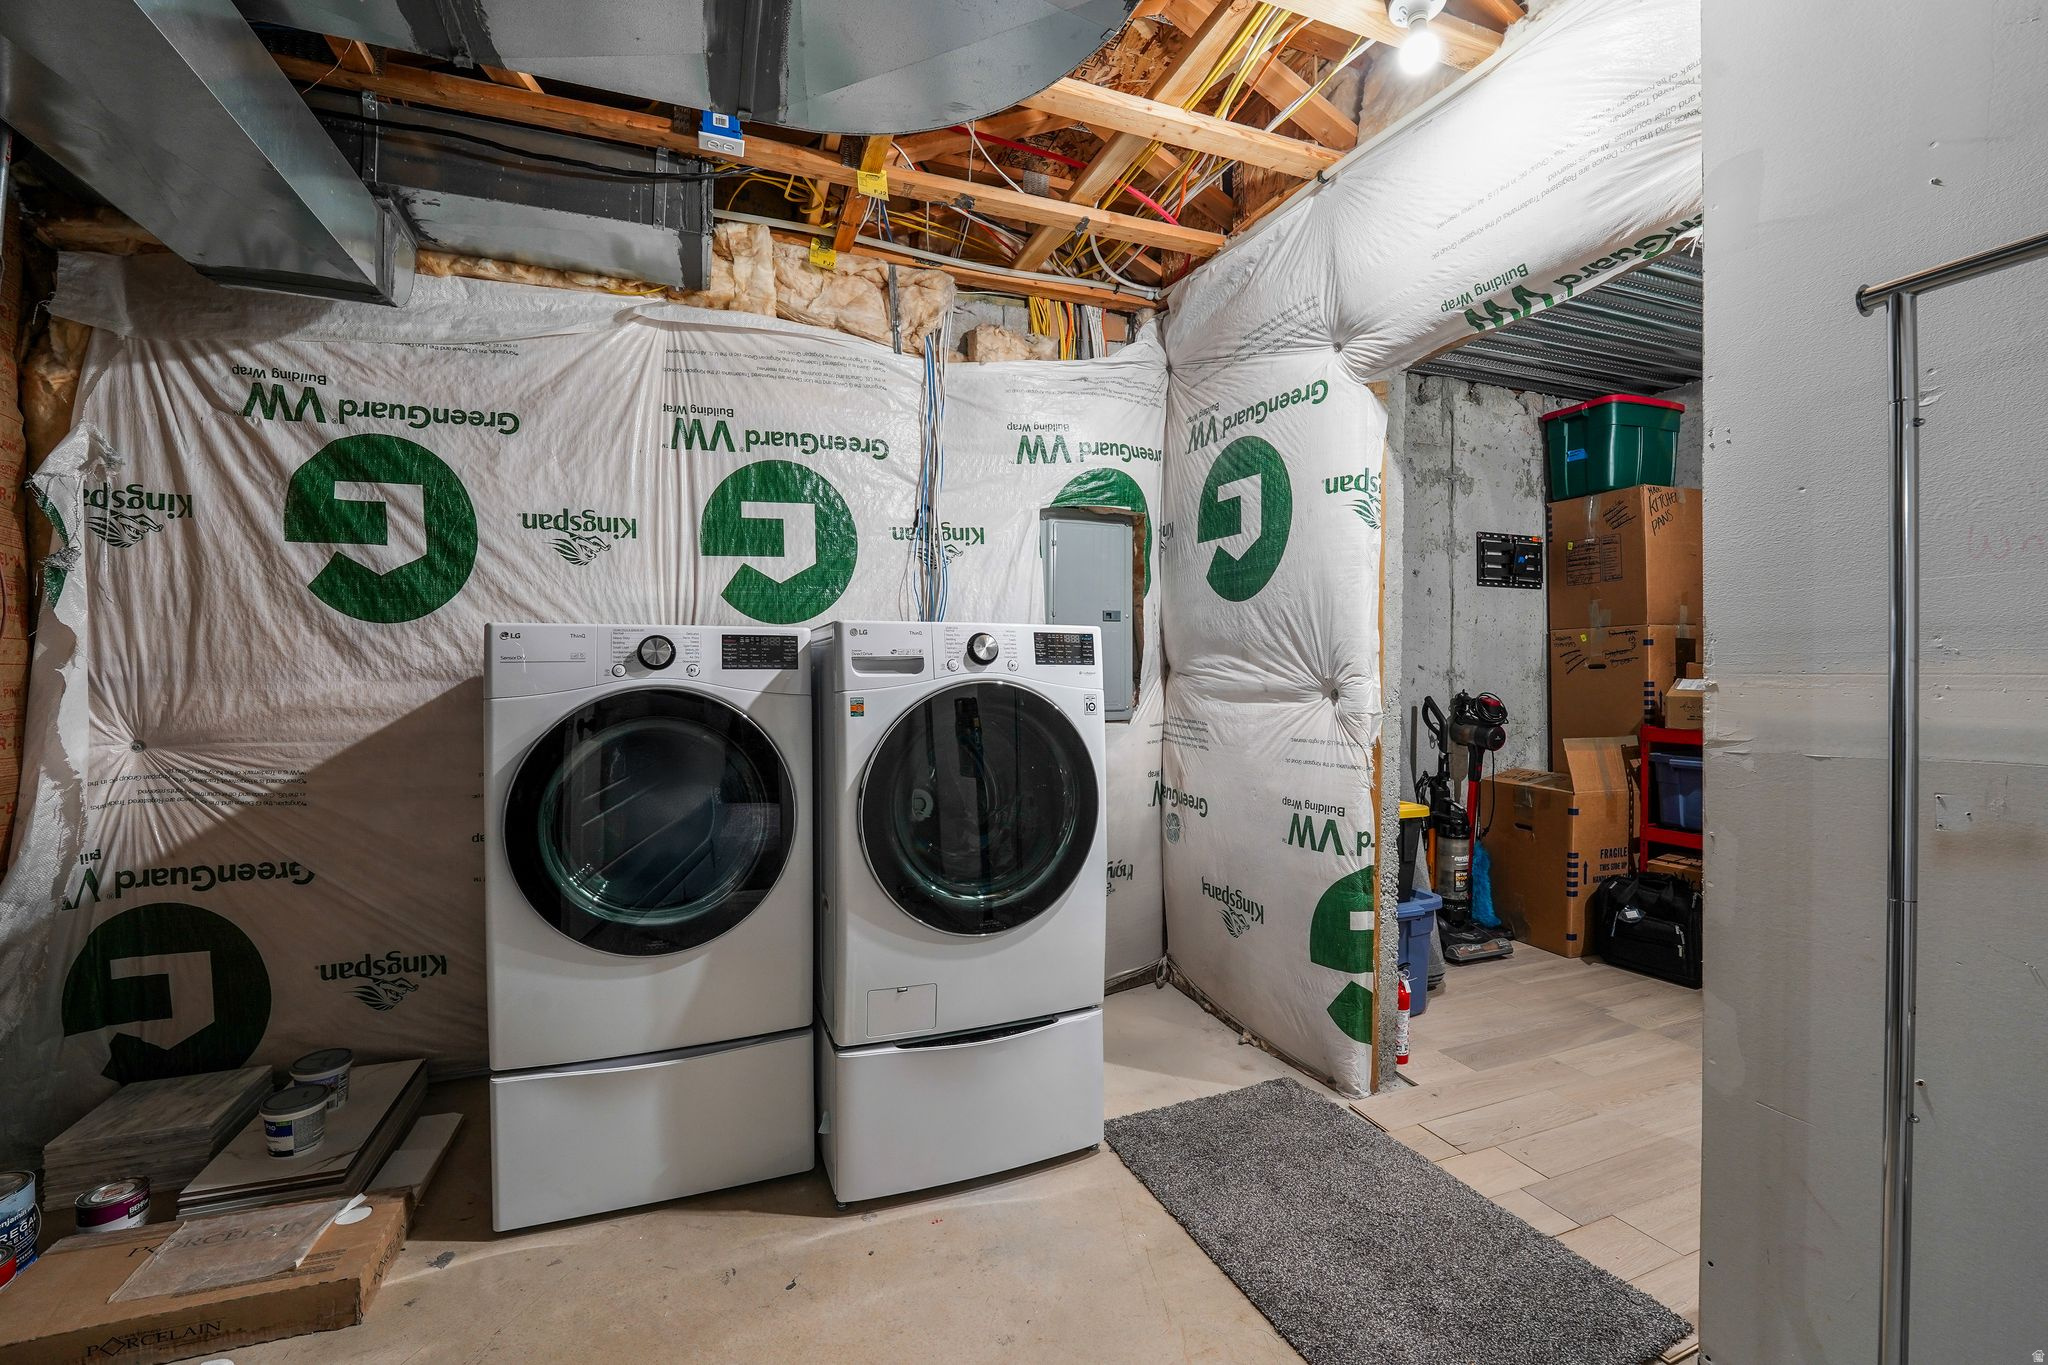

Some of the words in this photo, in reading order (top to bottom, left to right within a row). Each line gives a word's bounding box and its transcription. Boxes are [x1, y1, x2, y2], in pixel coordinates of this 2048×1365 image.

[1474, 262, 1528, 301] Building
[1440, 290, 1473, 314] Wrap
[231, 364, 266, 378] Wrap
[272, 368, 327, 385] Building
[689, 405, 734, 418] Building
[1651, 509, 1674, 536] PANS
[1281, 797, 1303, 810] Wrap
[1304, 799, 1346, 817] Building
[1600, 847, 1628, 859] FRAGILE
[320, 952, 448, 983] Kingspan
